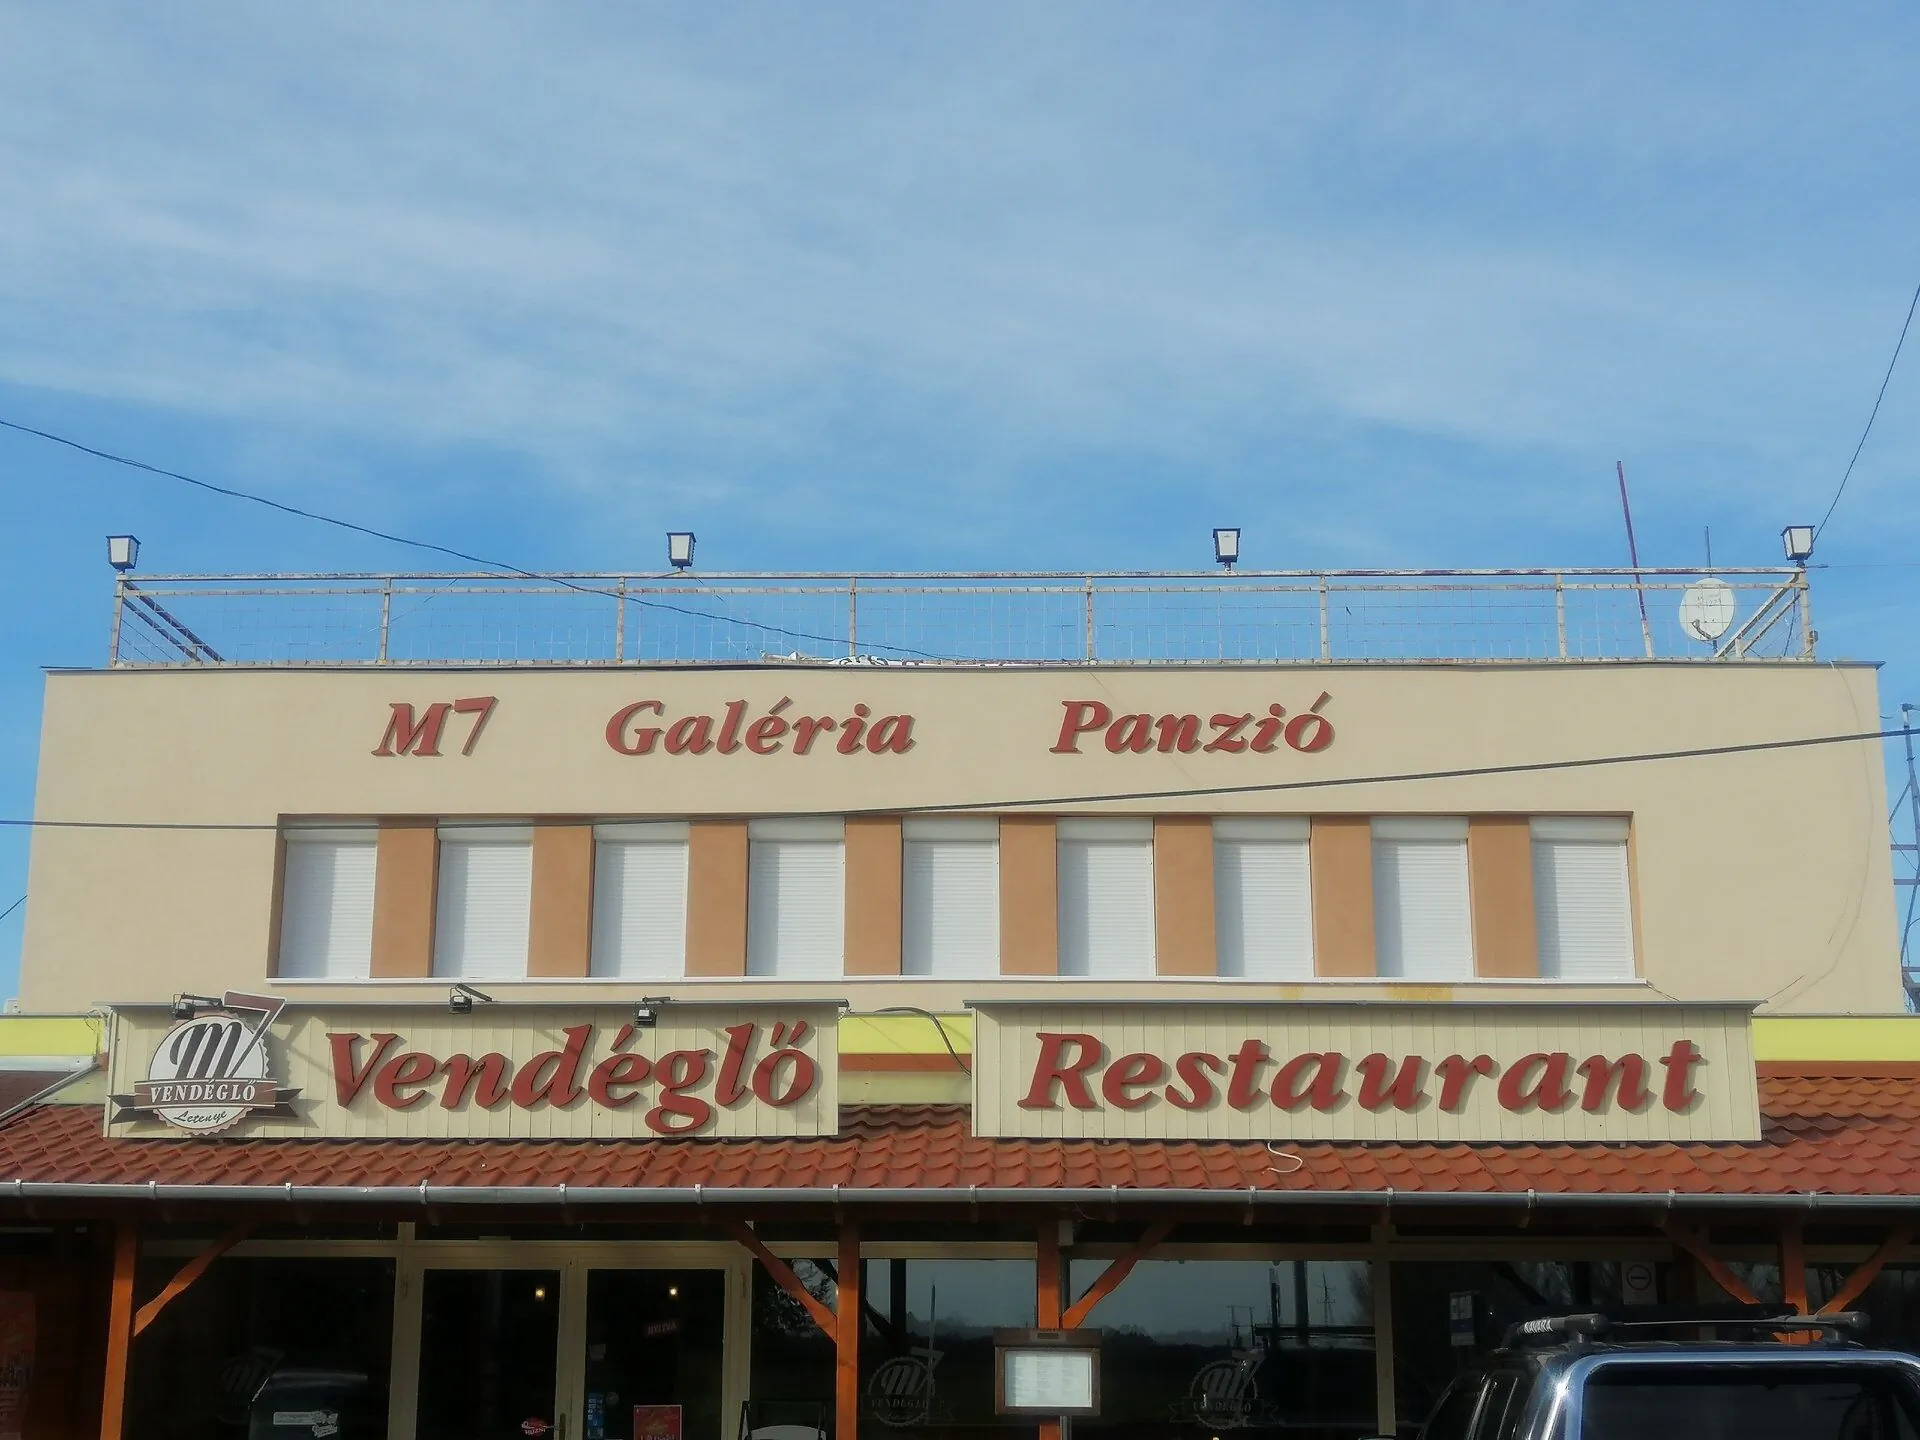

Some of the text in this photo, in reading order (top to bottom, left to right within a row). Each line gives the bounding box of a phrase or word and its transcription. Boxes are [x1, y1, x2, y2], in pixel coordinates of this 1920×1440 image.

[372, 691, 1334, 757] M7 Galéria Panzió
[150, 1079, 256, 1103] VENDÉGLŐ
[326, 1021, 815, 1134] Vendéglő
[1017, 1032, 1704, 1112] Restaurant
[174, 1110, 227, 1123] Letenye
